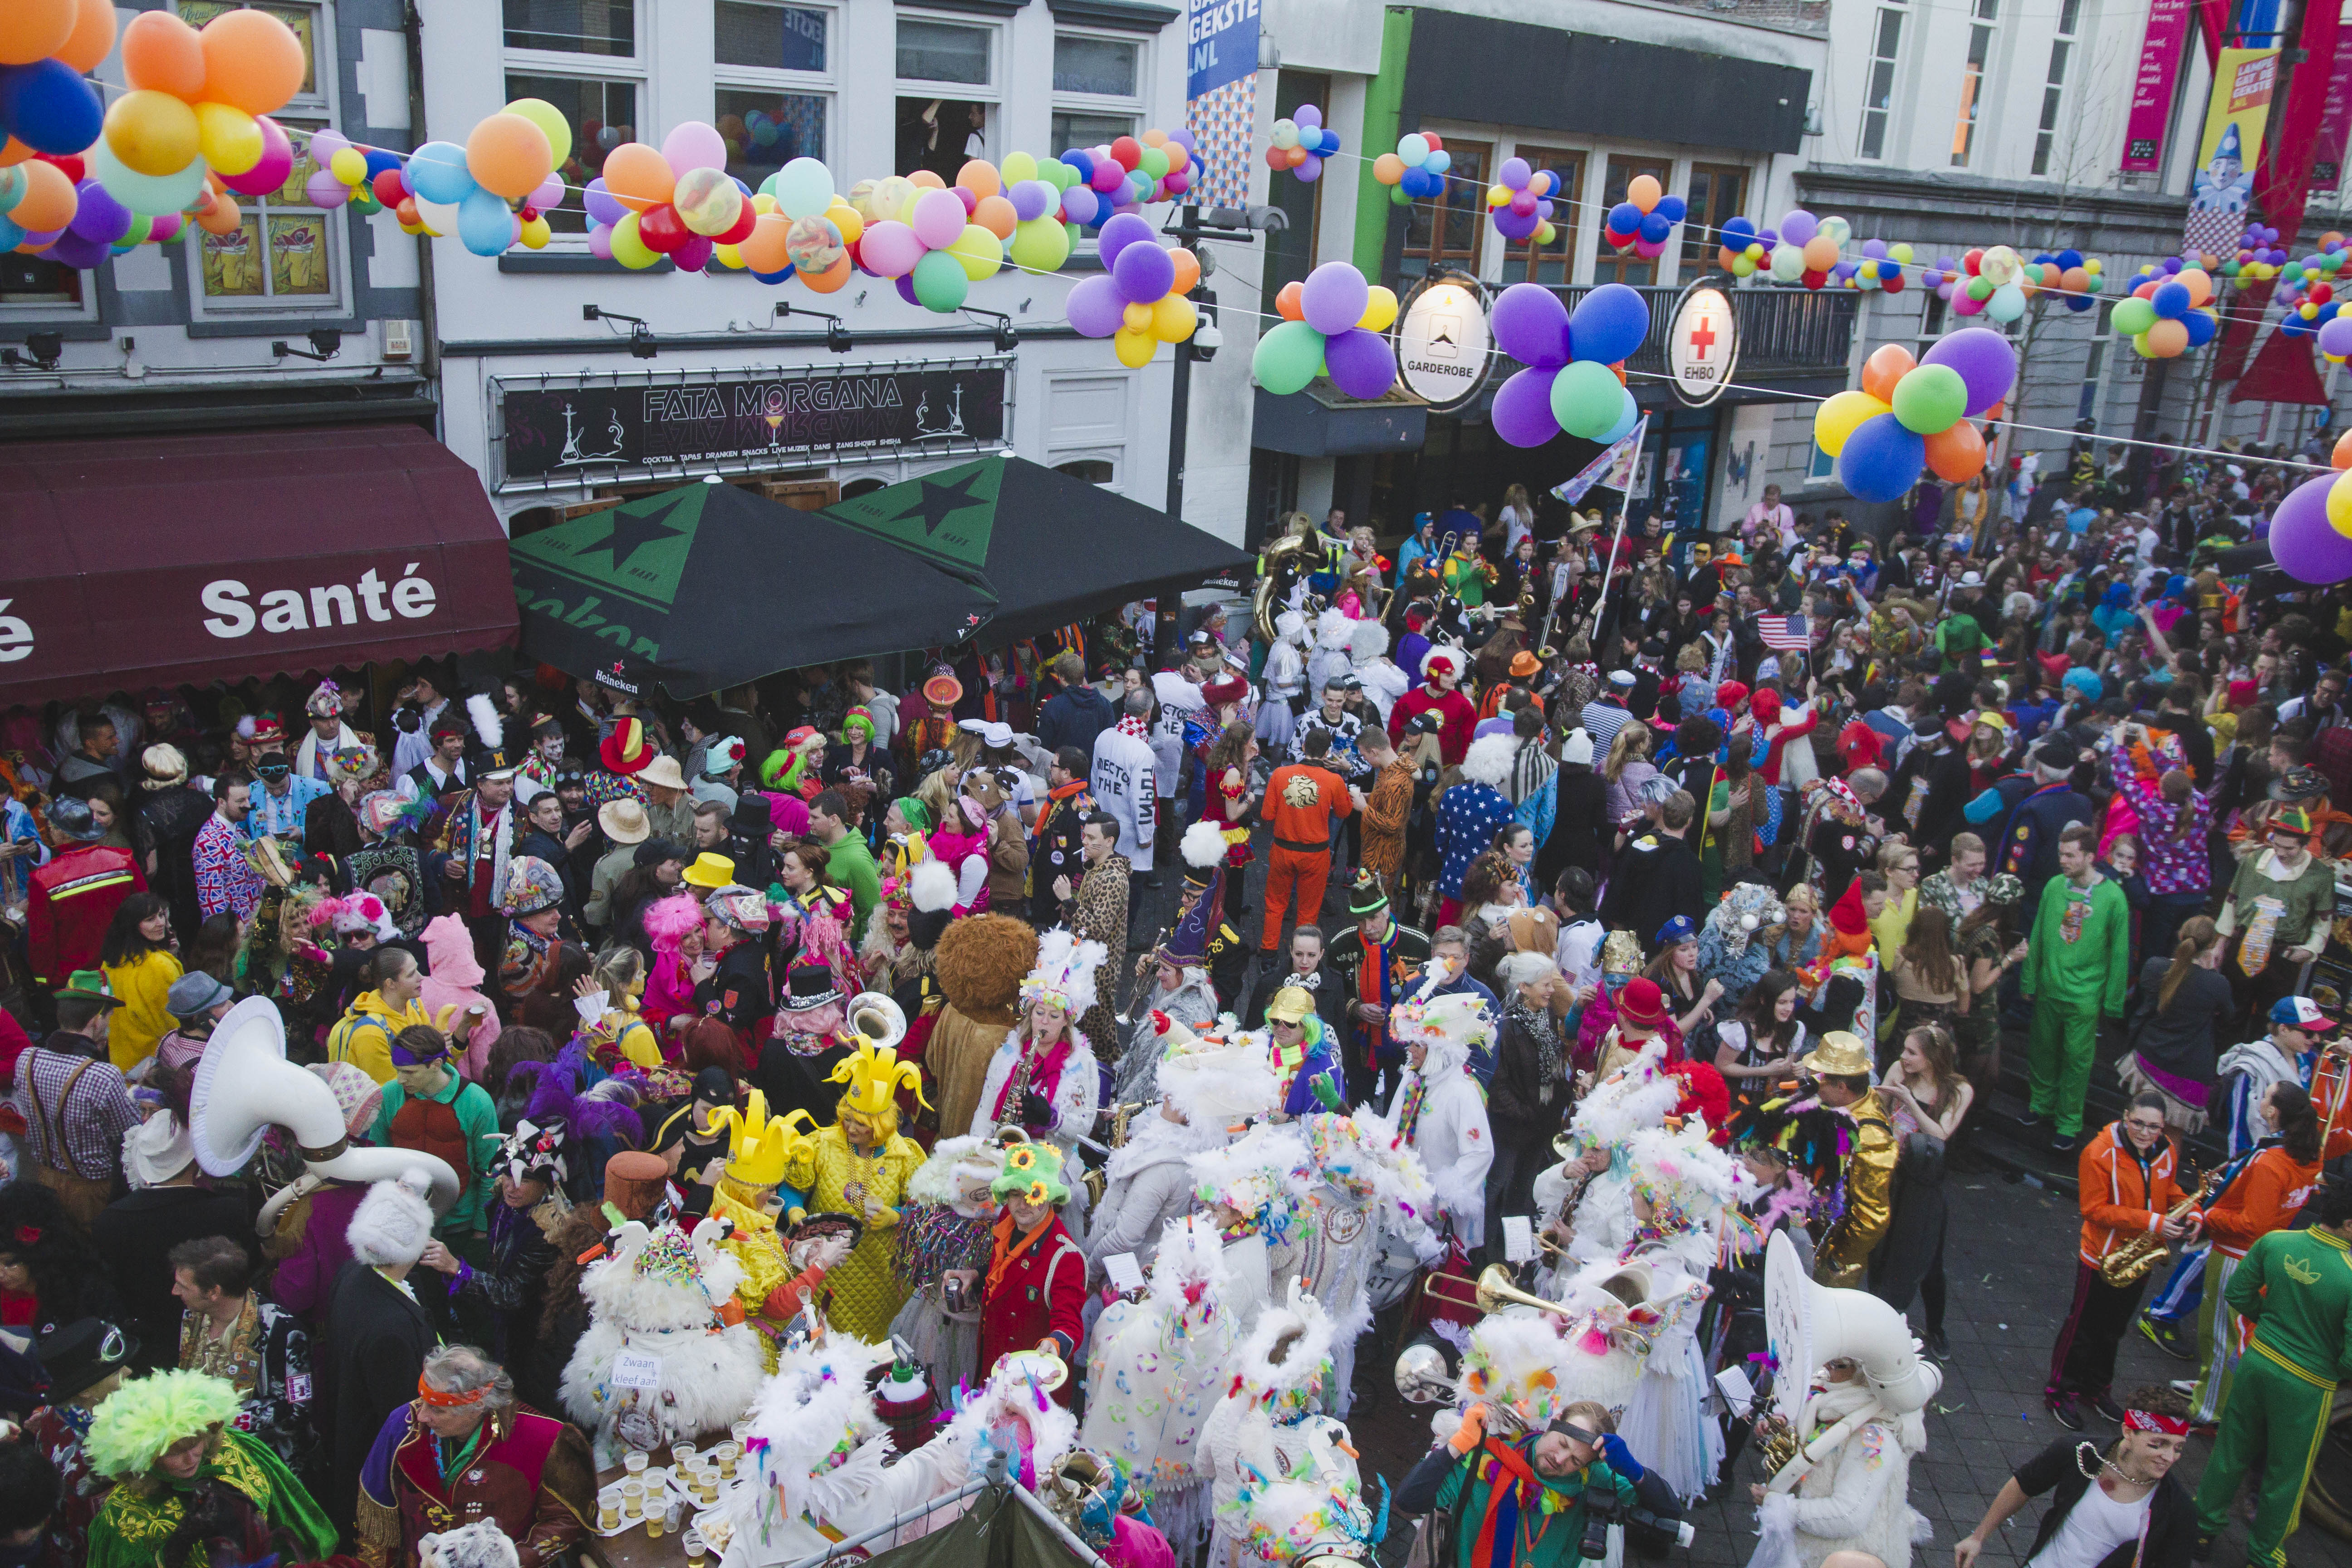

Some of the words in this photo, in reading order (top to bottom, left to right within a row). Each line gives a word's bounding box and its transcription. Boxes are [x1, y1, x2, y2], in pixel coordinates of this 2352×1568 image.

[1189, 0, 1259, 44] GEKSTE
[1187, 40, 1218, 77] .NL
[2238, 55, 2275, 77] LAMPE
[2261, 67, 2275, 79] DE
[2233, 78, 2273, 98] GEKSTE
[1408, 361, 1474, 377] GARDEROBE
[1684, 367, 1714, 379] EHBO
[644, 387, 726, 422] FATA
[735, 377, 903, 416] MORGANA
[642, 456, 675, 464] COCKTAIL
[706, 451, 738, 459] DRANKEN
[742, 448, 768, 456] SNACKS
[201, 562, 436, 638] Santé
[595, 669, 638, 694] Heineken
[493, 751, 505, 768] M
[1098, 776, 1122, 796] THE
[623, 1357, 654, 1368] Zwaan
[615, 1373, 639, 1384] kleef
[640, 1378, 657, 1386] aan
